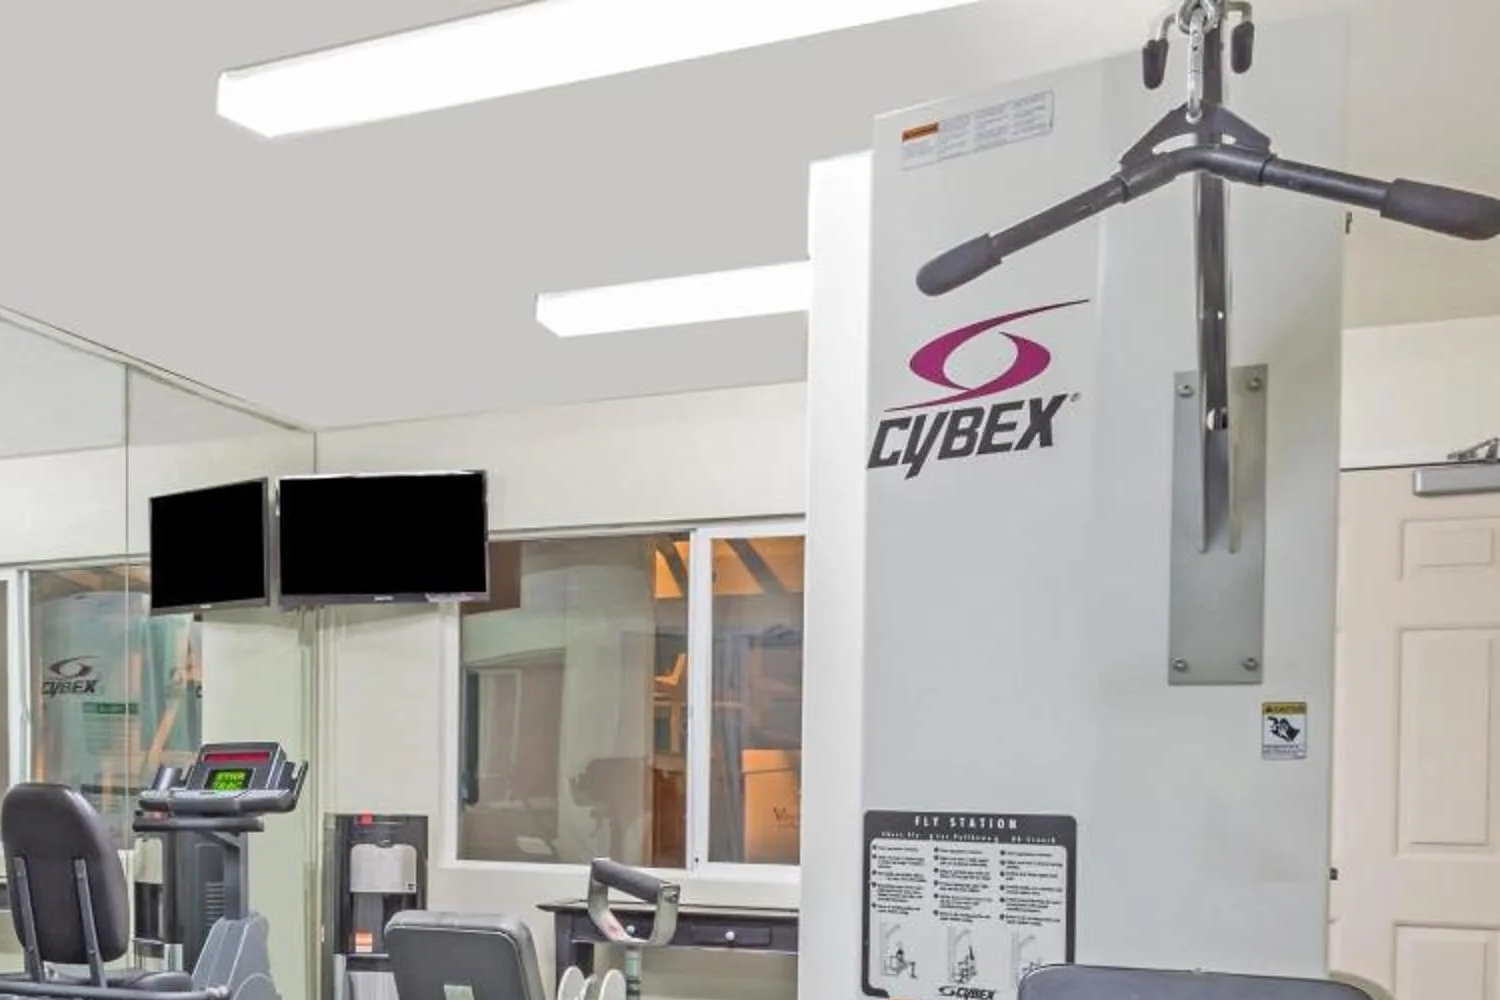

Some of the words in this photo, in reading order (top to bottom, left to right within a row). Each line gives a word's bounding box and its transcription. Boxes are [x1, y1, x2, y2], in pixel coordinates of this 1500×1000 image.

[867, 393, 1068, 480] CYBEX
[41, 679, 100, 698] CYBEX
[915, 815, 939, 827] FLY
[949, 816, 1017, 830] STATION
[956, 987, 997, 1000] CYBEX
